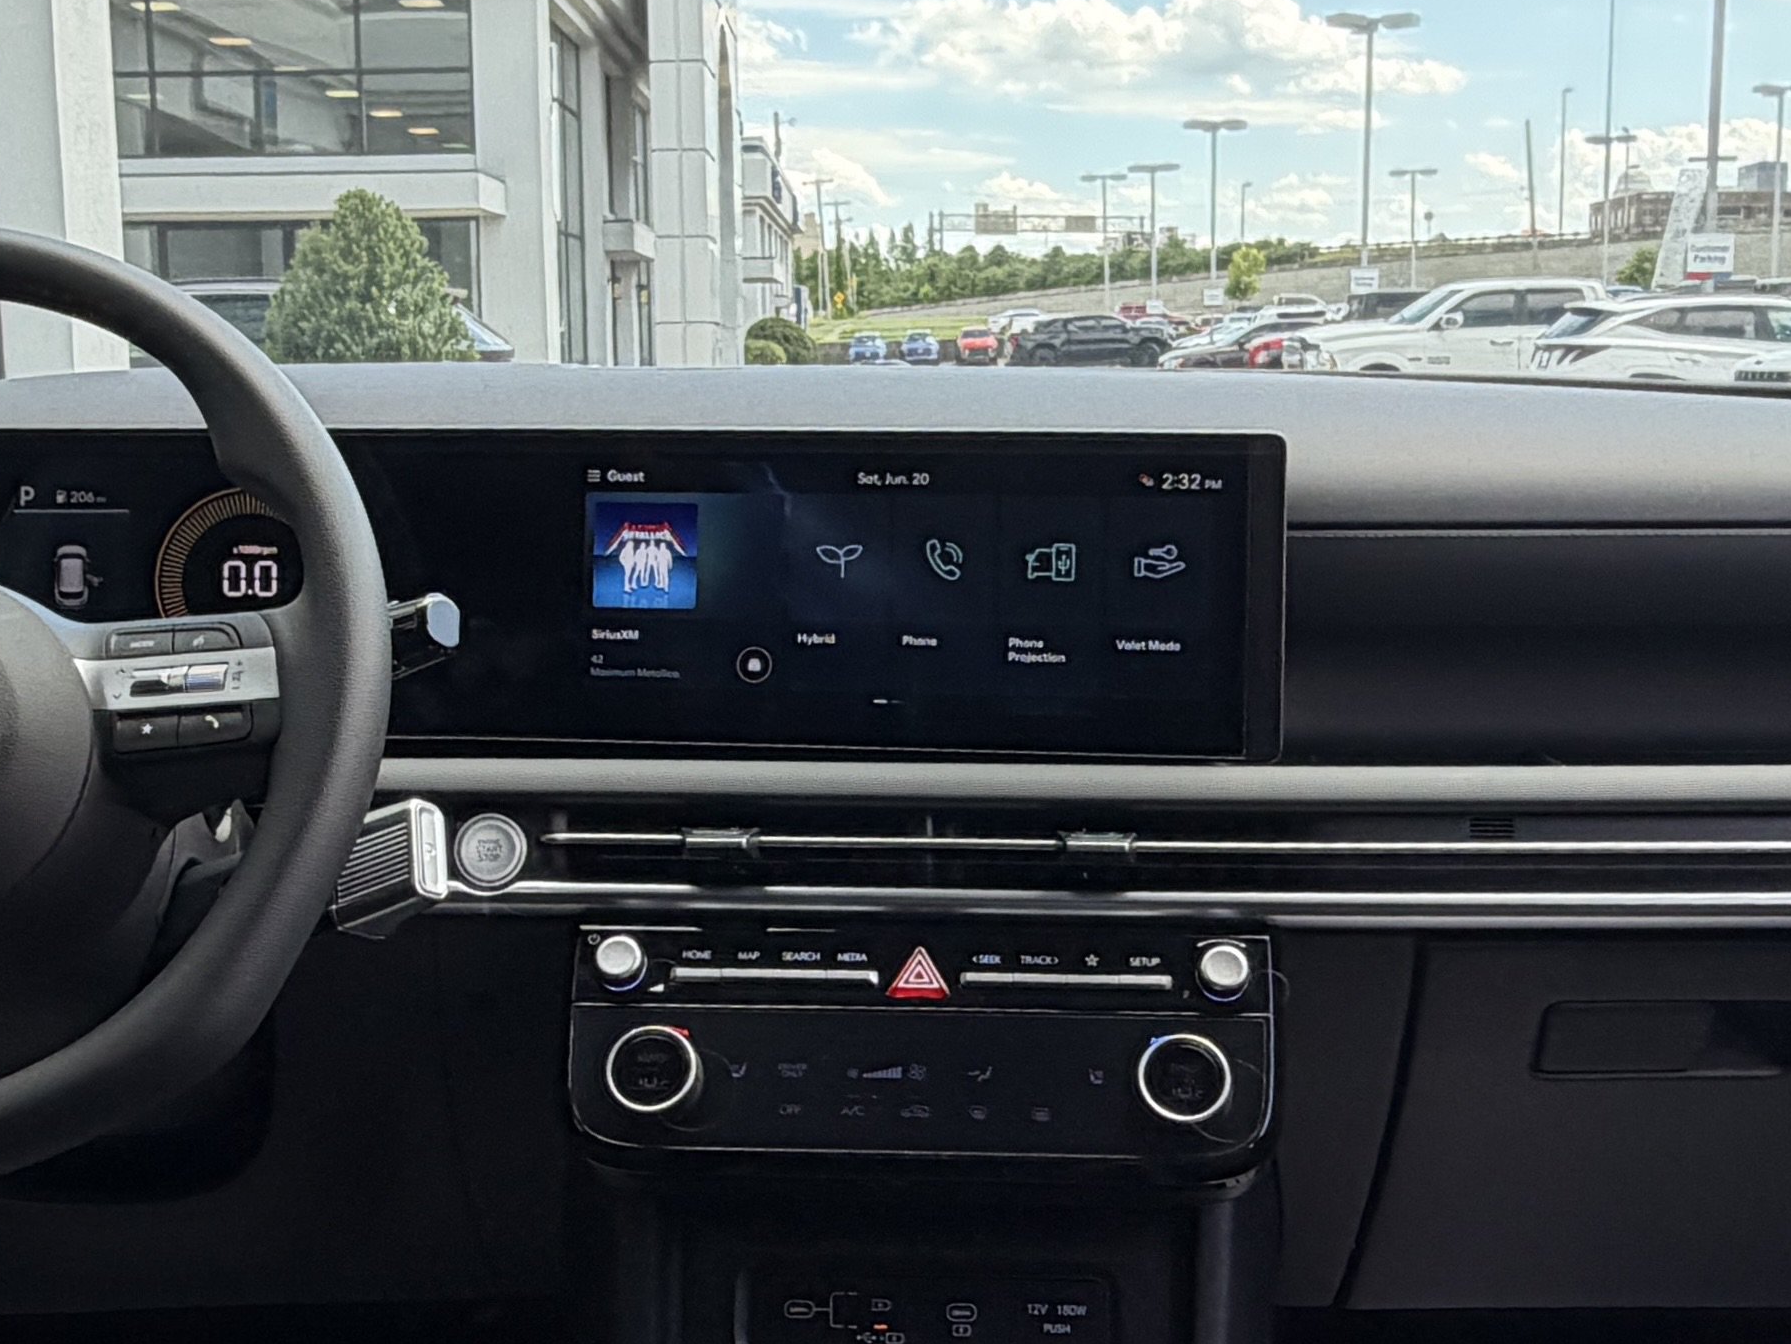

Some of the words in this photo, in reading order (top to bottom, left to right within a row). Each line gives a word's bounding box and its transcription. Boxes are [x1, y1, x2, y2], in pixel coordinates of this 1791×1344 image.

[607, 469, 645, 483] Guest
[857, 472, 882, 487] Sat,
[885, 472, 910, 486] Jun.
[911, 473, 929, 486] 20
[1161, 473, 1202, 490] 2:32
[19, 486, 35, 506] P
[70, 491, 94, 504] 206
[222, 560, 277, 597] 0.0
[591, 628, 639, 640] SiriusXM
[796, 632, 836, 646] Hybrid
[901, 634, 938, 647] Phone
[1009, 637, 1044, 649] Phone
[1115, 638, 1146, 652] Valet
[1148, 639, 1181, 652] Mode
[1007, 651, 1066, 665] Projection
[682, 950, 712, 961] HOME
[737, 951, 761, 961] MAP
[782, 951, 820, 962] SEARCH
[837, 952, 867, 963] MEDIA
[1129, 956, 1161, 967] SETUP
[1027, 1303, 1048, 1317] 12V
[1056, 1304, 1088, 1317] 180W
[1043, 1323, 1072, 1335] PUSH
